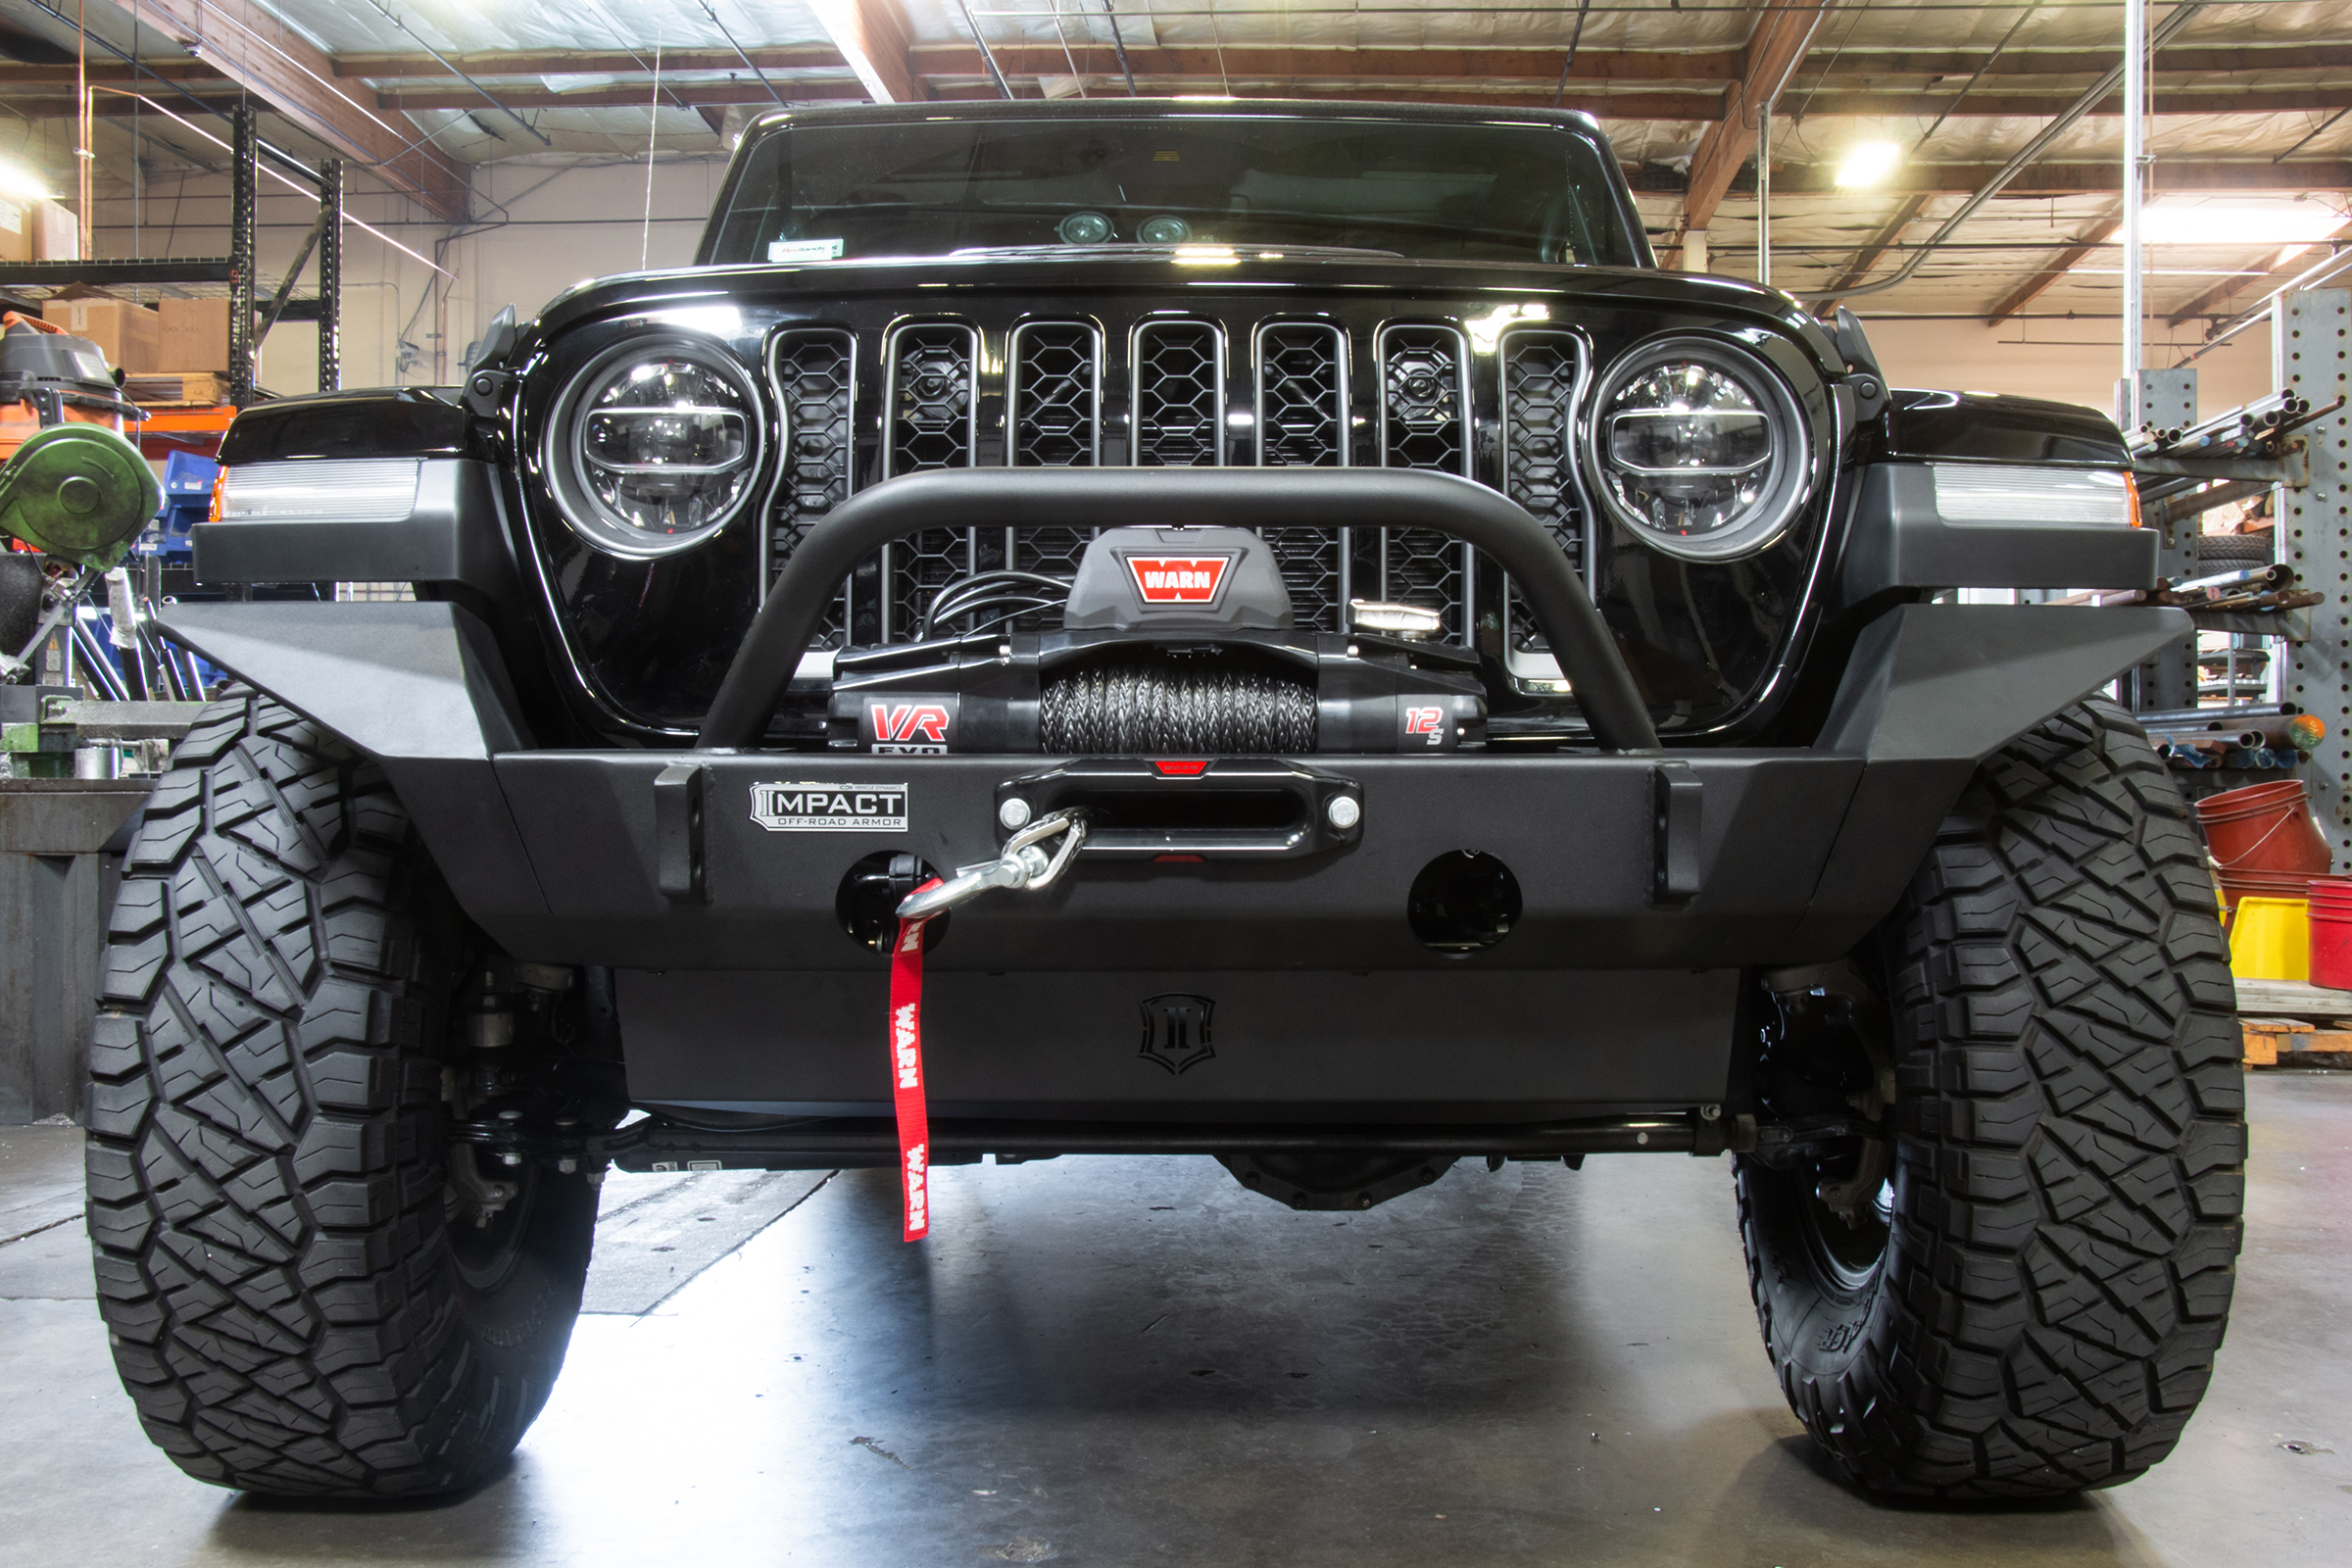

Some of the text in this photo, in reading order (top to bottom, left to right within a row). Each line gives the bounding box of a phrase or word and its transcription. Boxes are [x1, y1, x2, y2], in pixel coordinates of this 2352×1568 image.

[1145, 571, 1210, 588] WARN
[870, 704, 950, 741] VR
[895, 1004, 918, 1088] WARN
[906, 1144, 926, 1231] WARN
